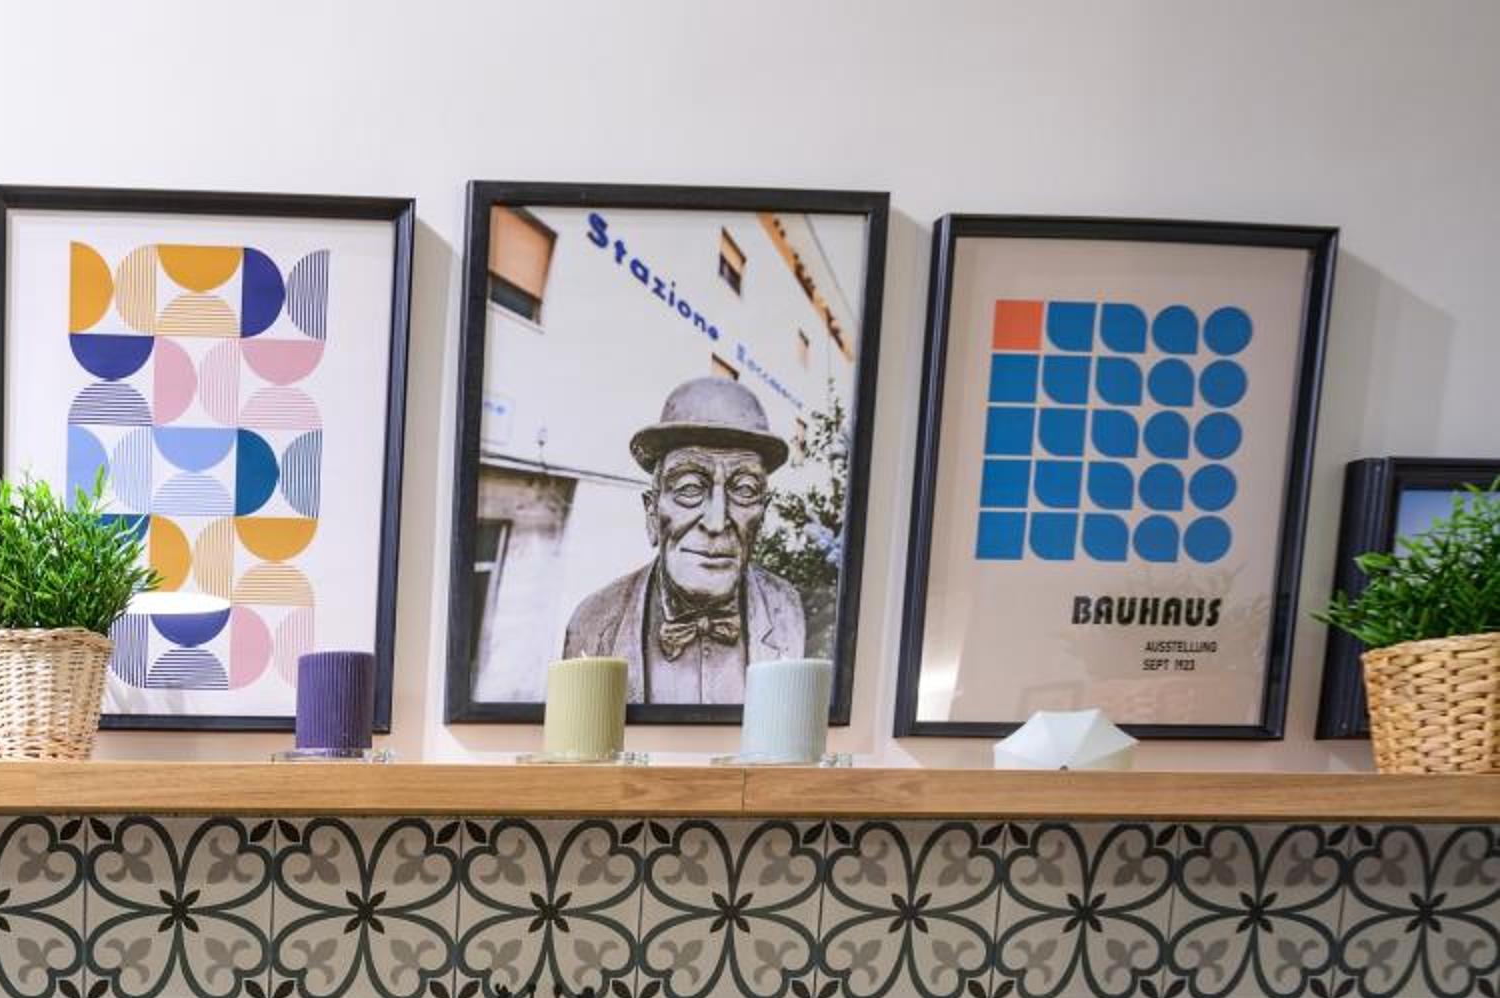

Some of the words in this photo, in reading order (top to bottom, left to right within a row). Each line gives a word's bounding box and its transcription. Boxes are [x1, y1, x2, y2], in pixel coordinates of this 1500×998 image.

[587, 212, 719, 341] Stazione
[1072, 595, 1222, 627] BAUHAUS
[1144, 640, 1217, 653] AUSSTELLUNG
[1143, 658, 1170, 671] SEPT
